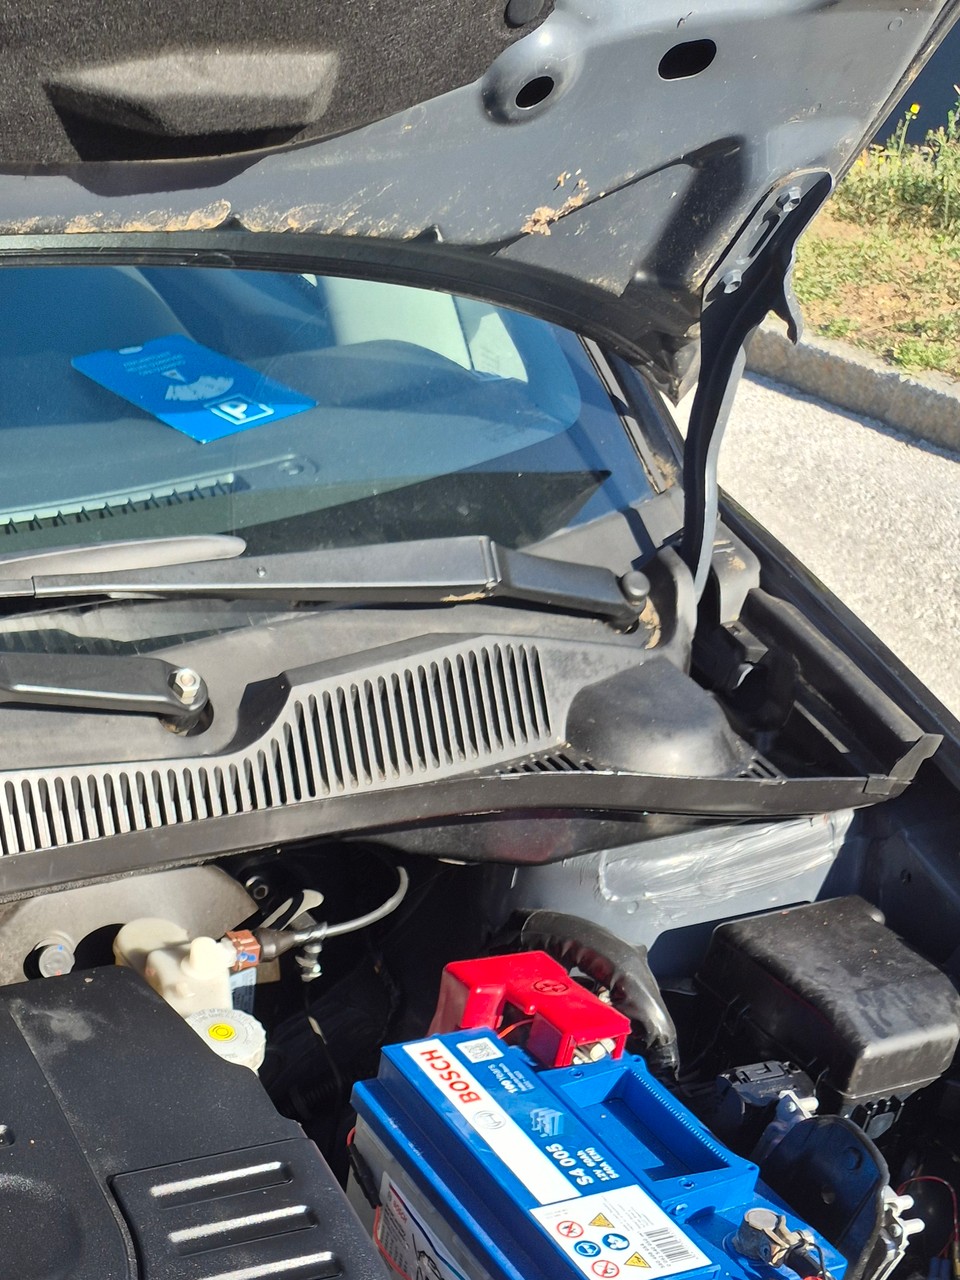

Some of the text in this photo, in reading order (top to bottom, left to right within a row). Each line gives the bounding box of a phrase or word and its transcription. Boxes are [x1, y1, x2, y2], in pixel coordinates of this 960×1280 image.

[420, 1049, 481, 1104] BOSCH
[545, 1143, 594, 1186] S4 005
[576, 1149, 610, 1181] 12V 60Ah
[584, 1147, 620, 1179] 540A (EN)
